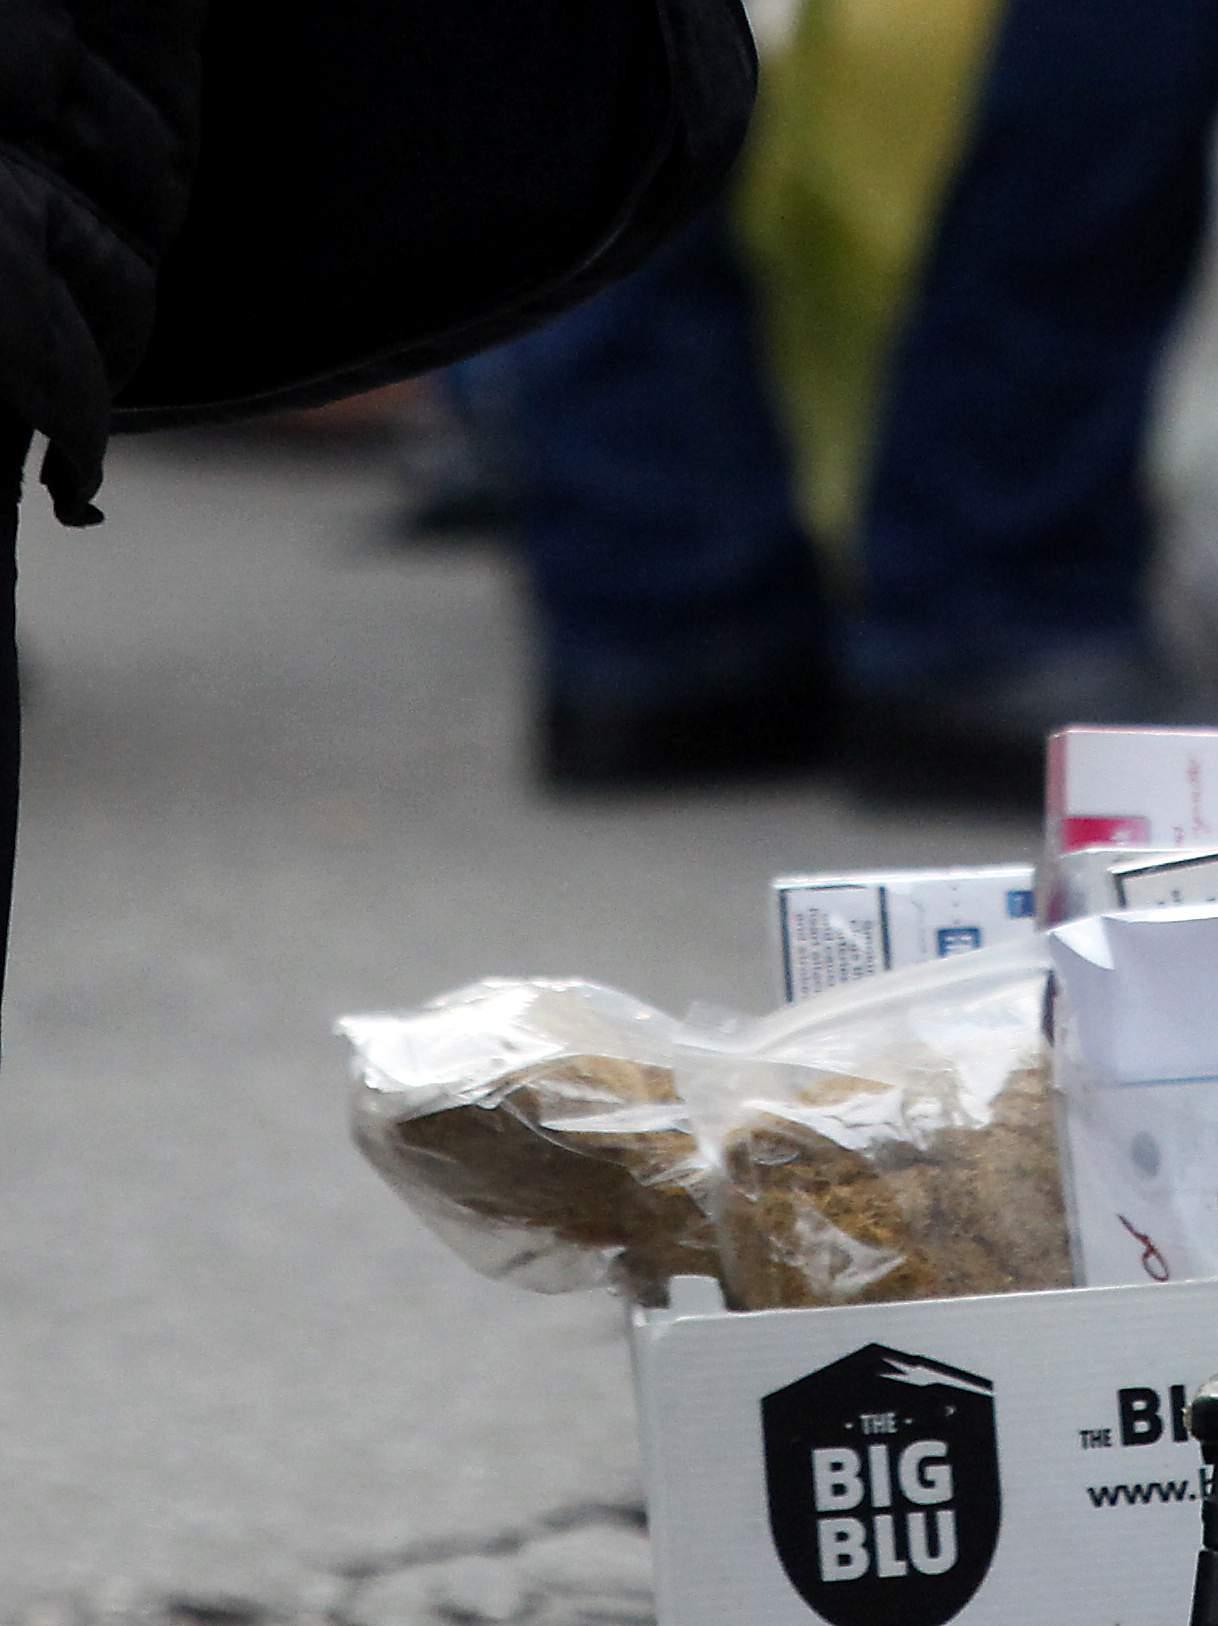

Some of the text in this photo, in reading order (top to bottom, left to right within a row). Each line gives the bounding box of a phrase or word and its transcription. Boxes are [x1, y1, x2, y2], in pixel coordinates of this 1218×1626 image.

[860, 1412, 898, 1434] THE
[1080, 1429, 1112, 1449] THE
[812, 1440, 954, 1512] BIG
[817, 1510, 958, 1582] BLU
